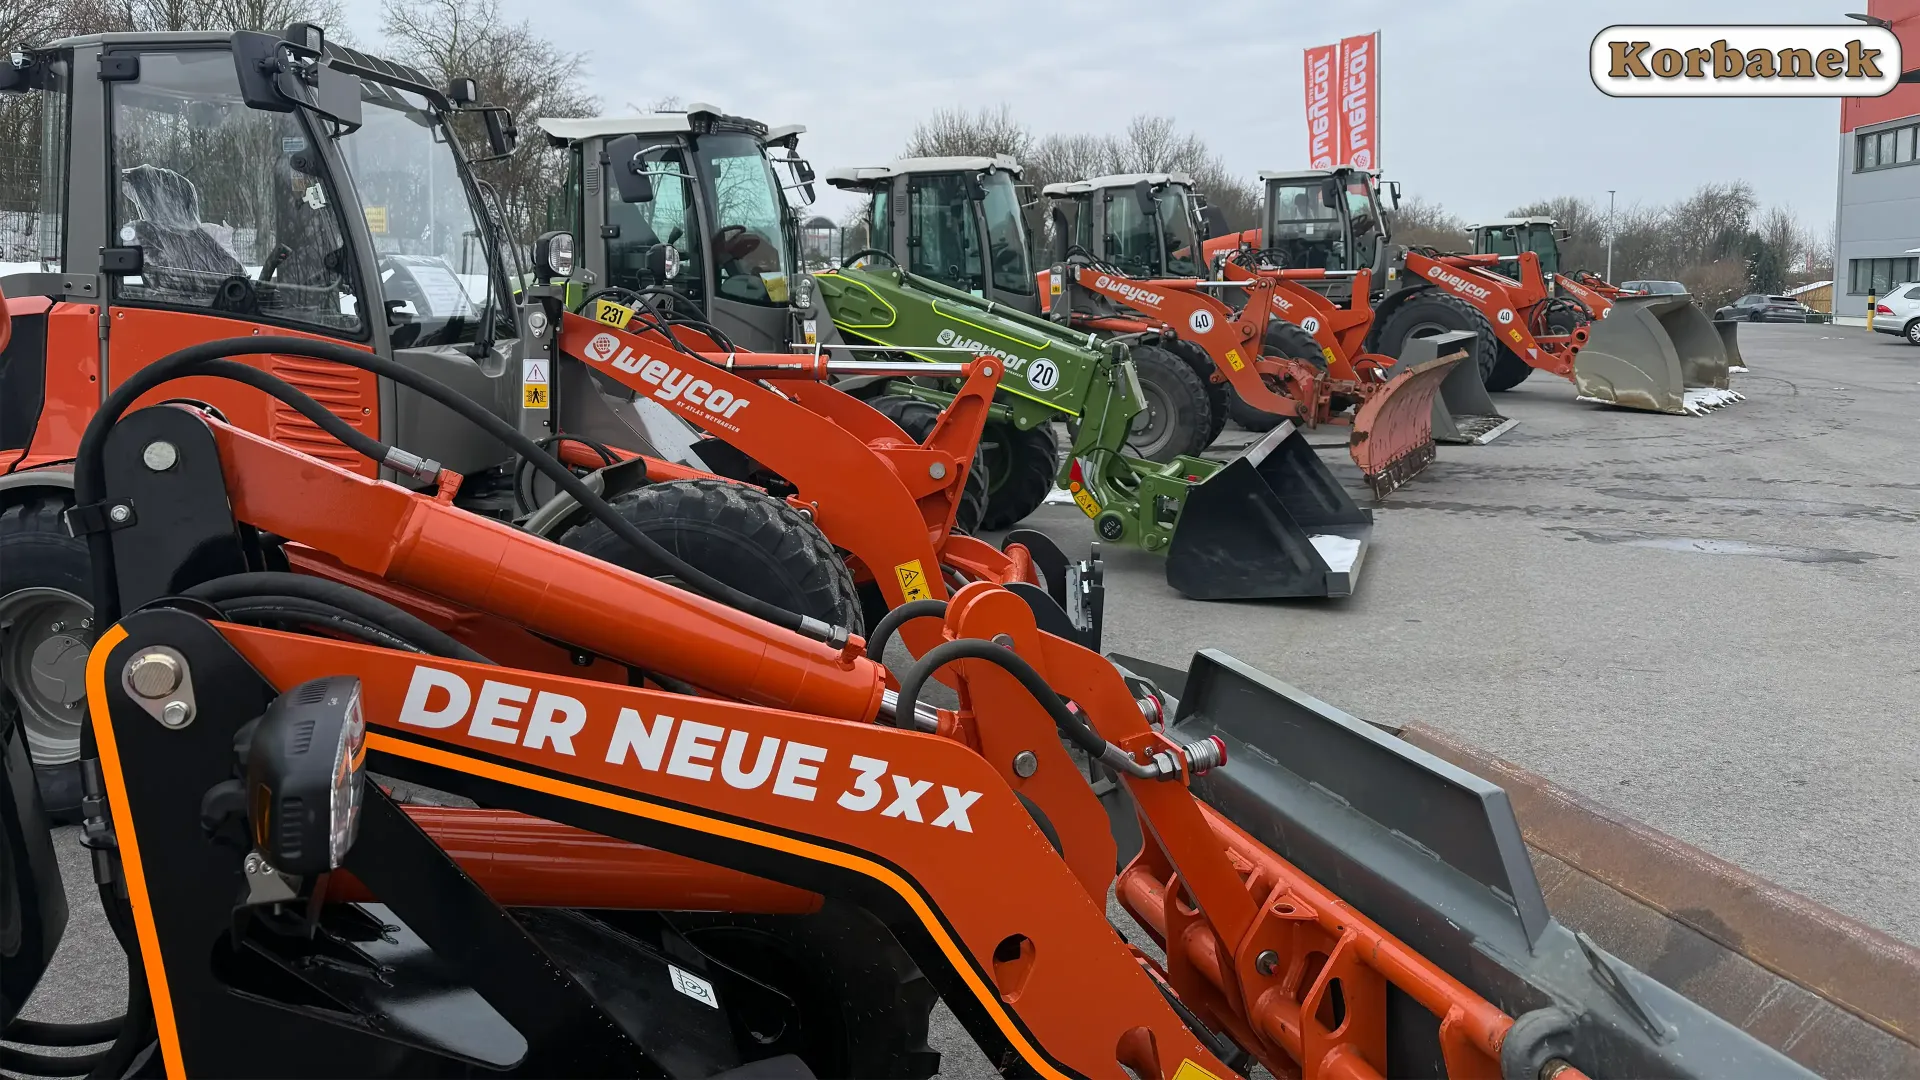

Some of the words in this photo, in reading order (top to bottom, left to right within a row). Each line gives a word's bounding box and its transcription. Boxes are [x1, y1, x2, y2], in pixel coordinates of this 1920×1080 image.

[1106, 280, 1165, 305] weycor
[1438, 270, 1492, 299] weycor
[1272, 293, 1294, 310] cor
[600, 305, 624, 325] 231
[1194, 314, 1209, 329] 40
[1304, 320, 1316, 332] 40
[1500, 311, 1510, 321] 40
[611, 345, 751, 419] weycor
[1031, 363, 1054, 386] 20
[676, 400, 686, 408] BY
[685, 405, 705, 416] ATLAS
[704, 413, 741, 433] WEYHAUSEN
[398, 664, 588, 757] DER
[604, 706, 828, 801] NEUE
